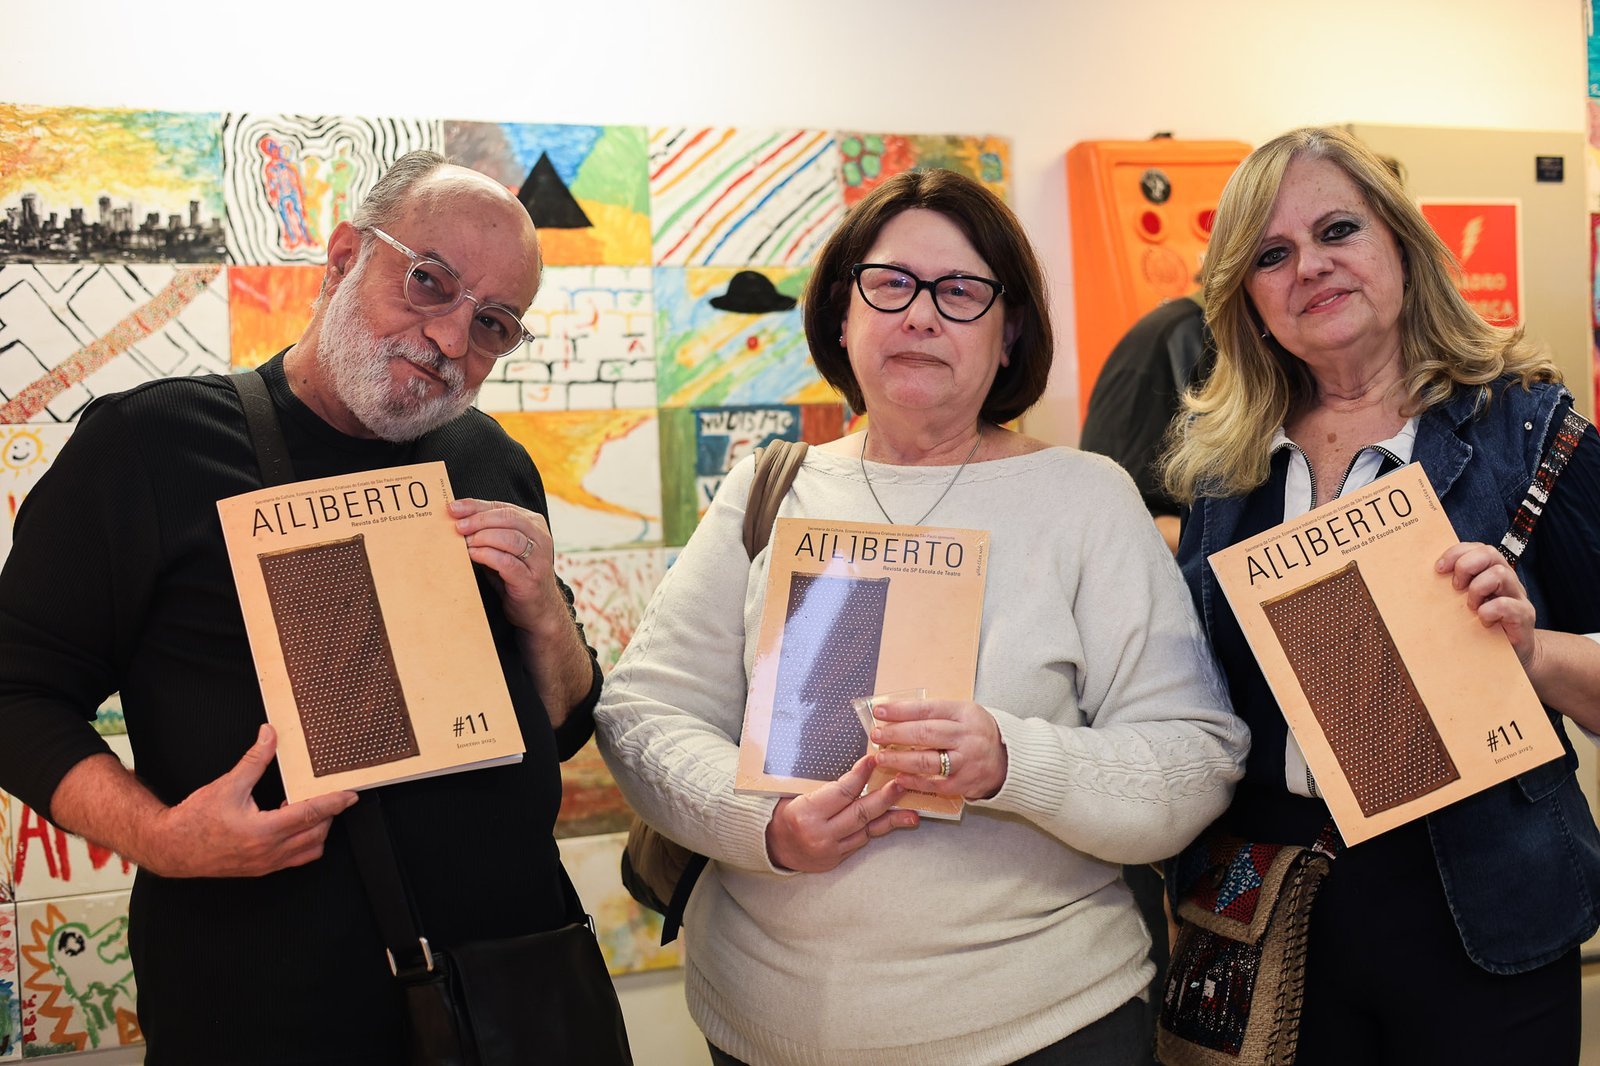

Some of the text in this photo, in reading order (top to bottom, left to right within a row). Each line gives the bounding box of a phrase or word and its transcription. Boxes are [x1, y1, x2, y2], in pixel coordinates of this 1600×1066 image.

[252, 481, 428, 537] A[L]BERTO
[795, 533, 963, 569] A[L]BERTO
[1247, 488, 1412, 585] A[L]BERTO
[1340, 542, 1360, 555] Revista
[1367, 535, 1376, 543] SP
[1376, 528, 1394, 539] Escola
[1401, 517, 1419, 528] Teatro
[453, 712, 488, 737] #11
[1487, 720, 1523, 752] #11
